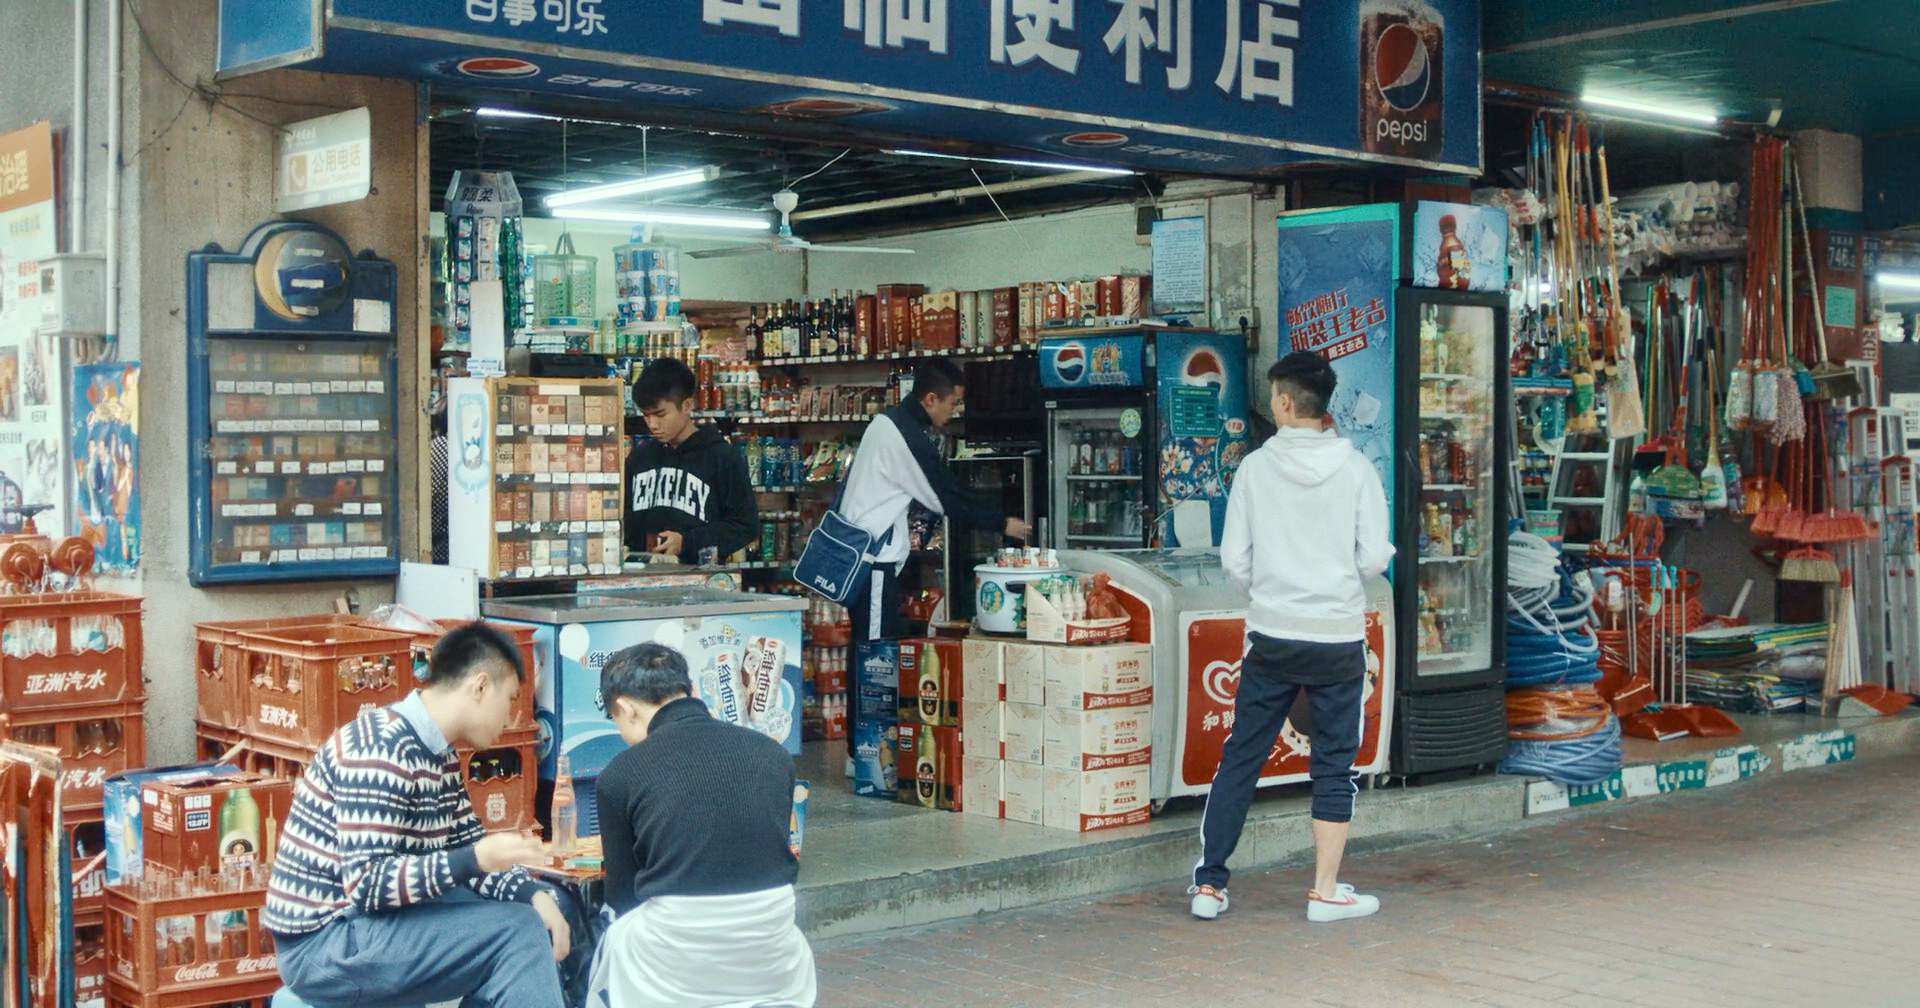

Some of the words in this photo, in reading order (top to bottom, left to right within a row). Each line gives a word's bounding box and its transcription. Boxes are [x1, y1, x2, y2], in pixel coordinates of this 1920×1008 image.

[466, 0, 608, 36] 百事可乐
[1376, 118, 1428, 146] pepsi
[312, 144, 361, 174] 公用电话
[814, 575, 837, 593] FILA
[22, 668, 107, 695] 亚洲汽水
[259, 703, 299, 729] 亚洲汽水
[61, 766, 106, 789] 汽水
[174, 961, 220, 983] Coca-Cola
